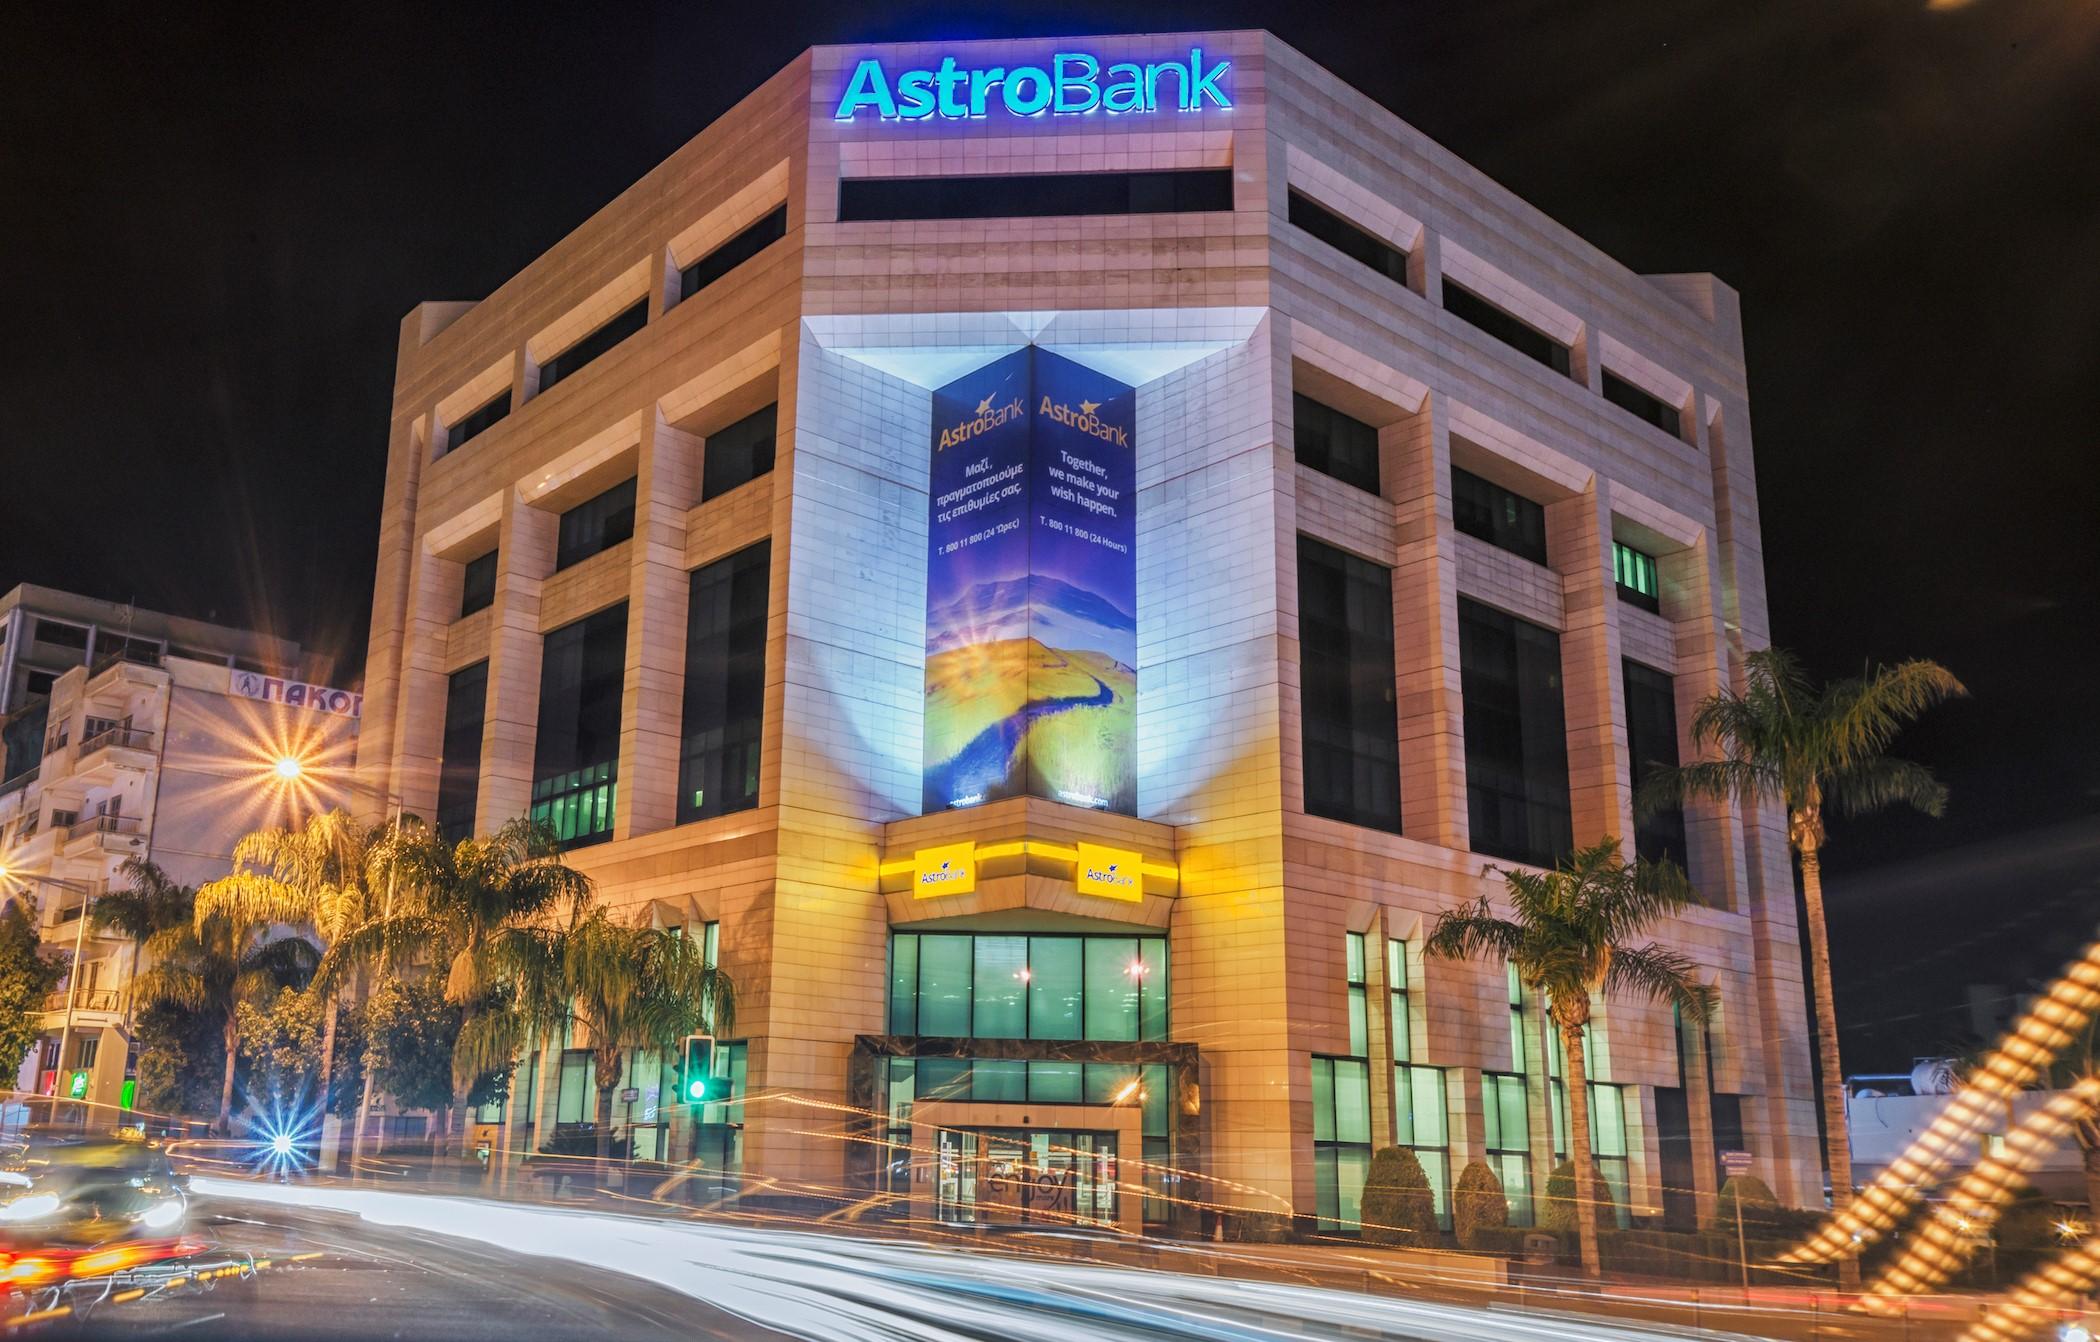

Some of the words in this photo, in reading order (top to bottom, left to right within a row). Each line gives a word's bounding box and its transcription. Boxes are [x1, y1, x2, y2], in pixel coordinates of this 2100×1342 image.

[835, 49, 1232, 120] AstroBank
[938, 397, 1024, 451] AstroBank
[1040, 396, 1128, 448] AstroBank
[965, 457, 993, 478] Μαζί,
[1061, 450, 1108, 480] Together,
[937, 463, 1024, 507] πραγματοποιούμε
[1048, 466, 1065, 480] we
[1066, 473, 1095, 491] make
[1096, 484, 1119, 500] your
[937, 511, 952, 523] τις
[952, 491, 1000, 519] επιθυμίες
[1050, 486, 1075, 503] wish
[1077, 492, 1117, 518] happen.
[946, 541, 959, 553] 800
[959, 538, 968, 548] 11
[969, 532, 982, 545] 800
[983, 528, 995, 541] (24
[1040, 515, 1048, 526] T.
[1049, 518, 1063, 531] 800
[1064, 524, 1073, 535] 11
[1075, 527, 1089, 540] 800
[1089, 533, 1101, 543] (24
[1102, 538, 1127, 554] Hours)
